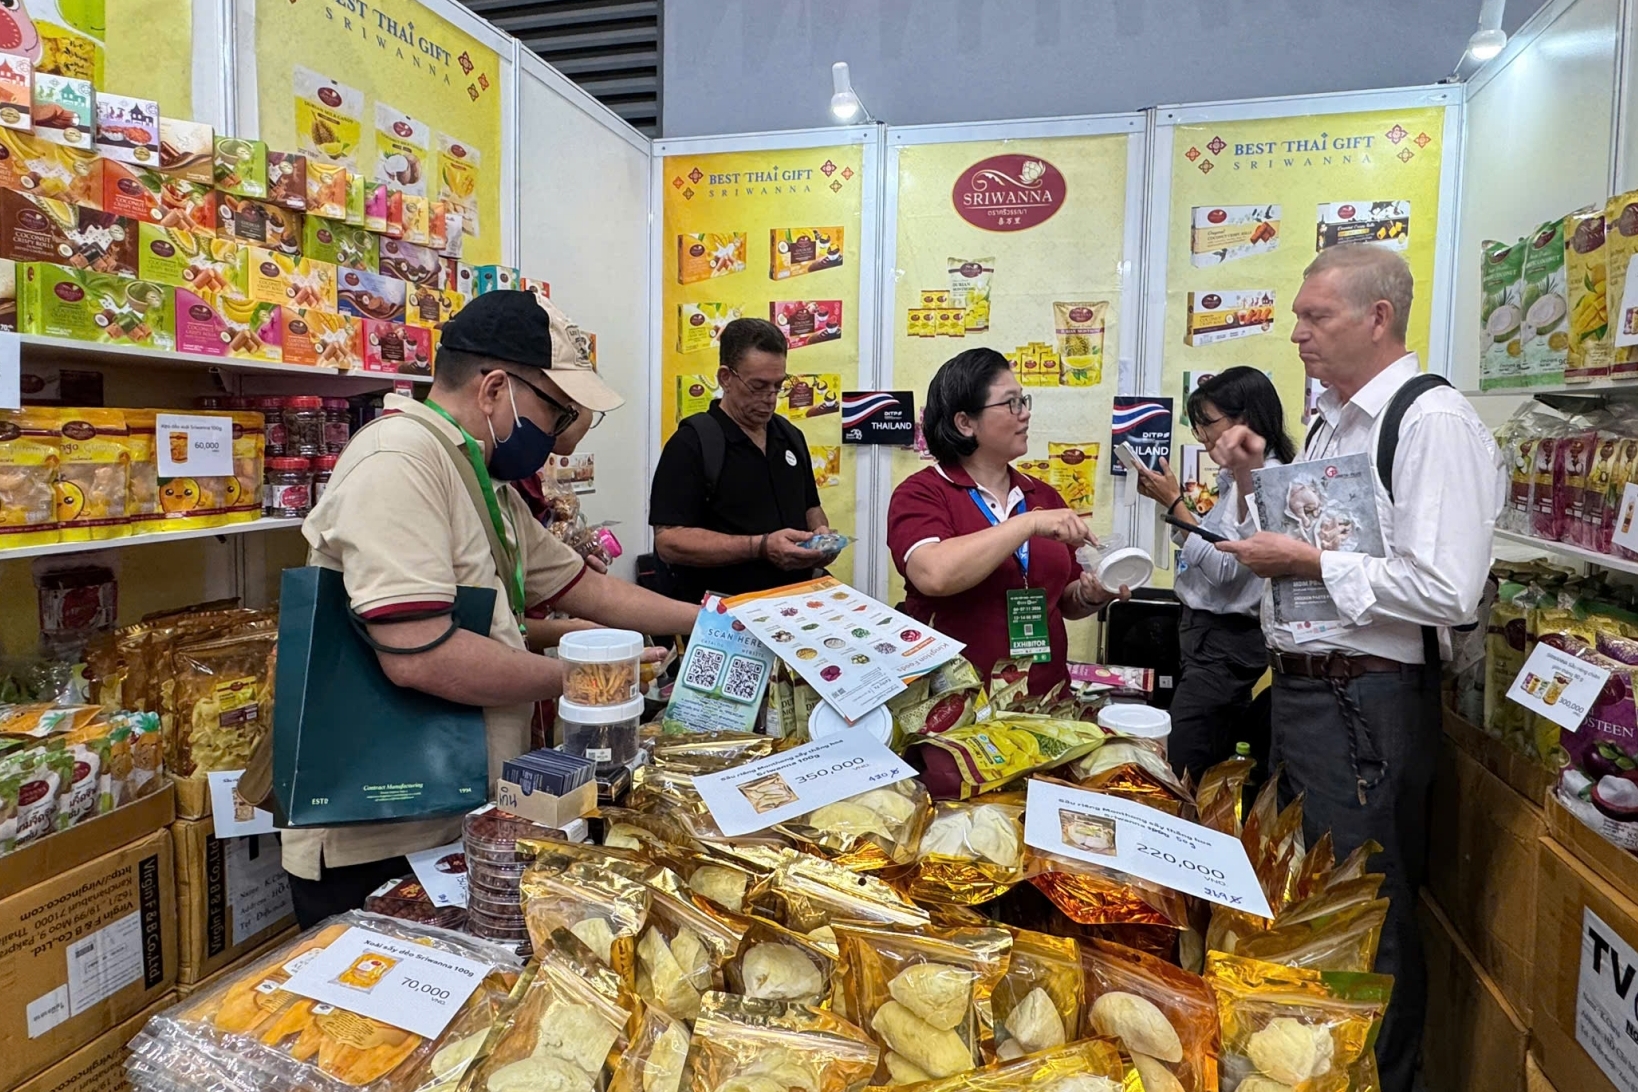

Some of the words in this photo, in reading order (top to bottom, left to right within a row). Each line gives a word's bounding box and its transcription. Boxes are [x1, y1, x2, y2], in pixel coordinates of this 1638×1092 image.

[336, 0, 368, 18] EST
[419, 36, 451, 67] GIFT
[325, 7, 451, 86] SRIWANNA
[1234, 142, 1277, 157] BEST
[1332, 136, 1375, 150] GIFT
[1233, 154, 1372, 171] SRIWANNA
[709, 173, 740, 185] BEST
[782, 169, 813, 181] GIFT
[709, 185, 811, 197] SRIWANNA
[963, 189, 1053, 206] SRIWANNA
[15, 231, 51, 243] COCONUT
[871, 421, 912, 430] THAILAND
[194, 442, 219, 450] 60,000
[708, 628, 734, 641] SCAN
[738, 635, 762, 648] HERE
[1013, 639, 1046, 648] EXHIBITOR
[1558, 696, 1585, 714] 300,000
[756, 761, 797, 777] Sriwanna
[797, 754, 821, 765] 100g
[795, 757, 865, 784] 350,000
[386, 782, 424, 790] Manufacturing
[1104, 813, 1147, 829] Sriwanna
[1136, 842, 1225, 880] 220,000
[141, 859, 156, 897] Virgin
[20, 865, 132, 922] http://virgincoco.com
[34, 908, 67, 929] 71000
[103, 901, 134, 919] Virgin
[48, 918, 72, 934] Moo
[84, 920, 93, 930] &
[415, 953, 453, 972] Sriwanna
[454, 965, 475, 978] 100g
[1588, 925, 1637, 1001] TV
[401, 976, 451, 1000] 70,000
